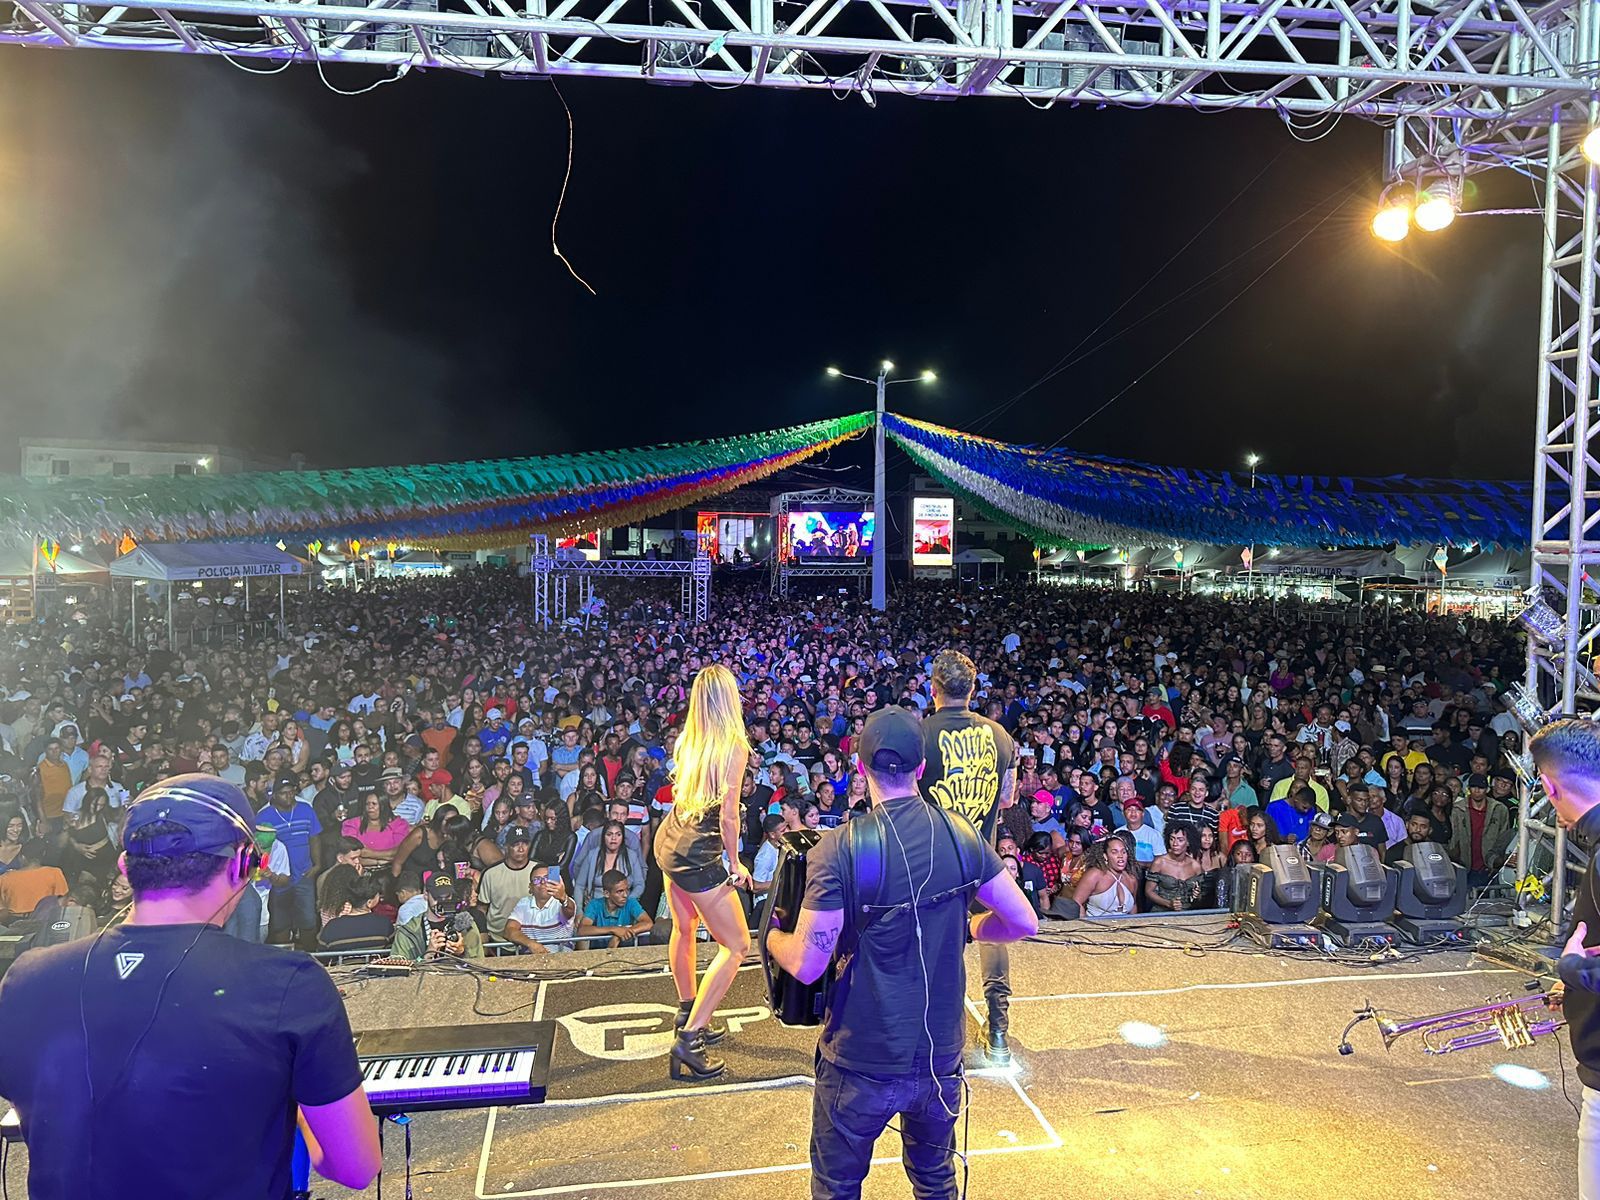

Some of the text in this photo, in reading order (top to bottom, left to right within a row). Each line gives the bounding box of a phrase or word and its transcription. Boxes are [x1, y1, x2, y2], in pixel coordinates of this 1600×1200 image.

[198, 564, 281, 577] POLICIA MILITAR
[1310, 566, 1342, 576] MILITAR
